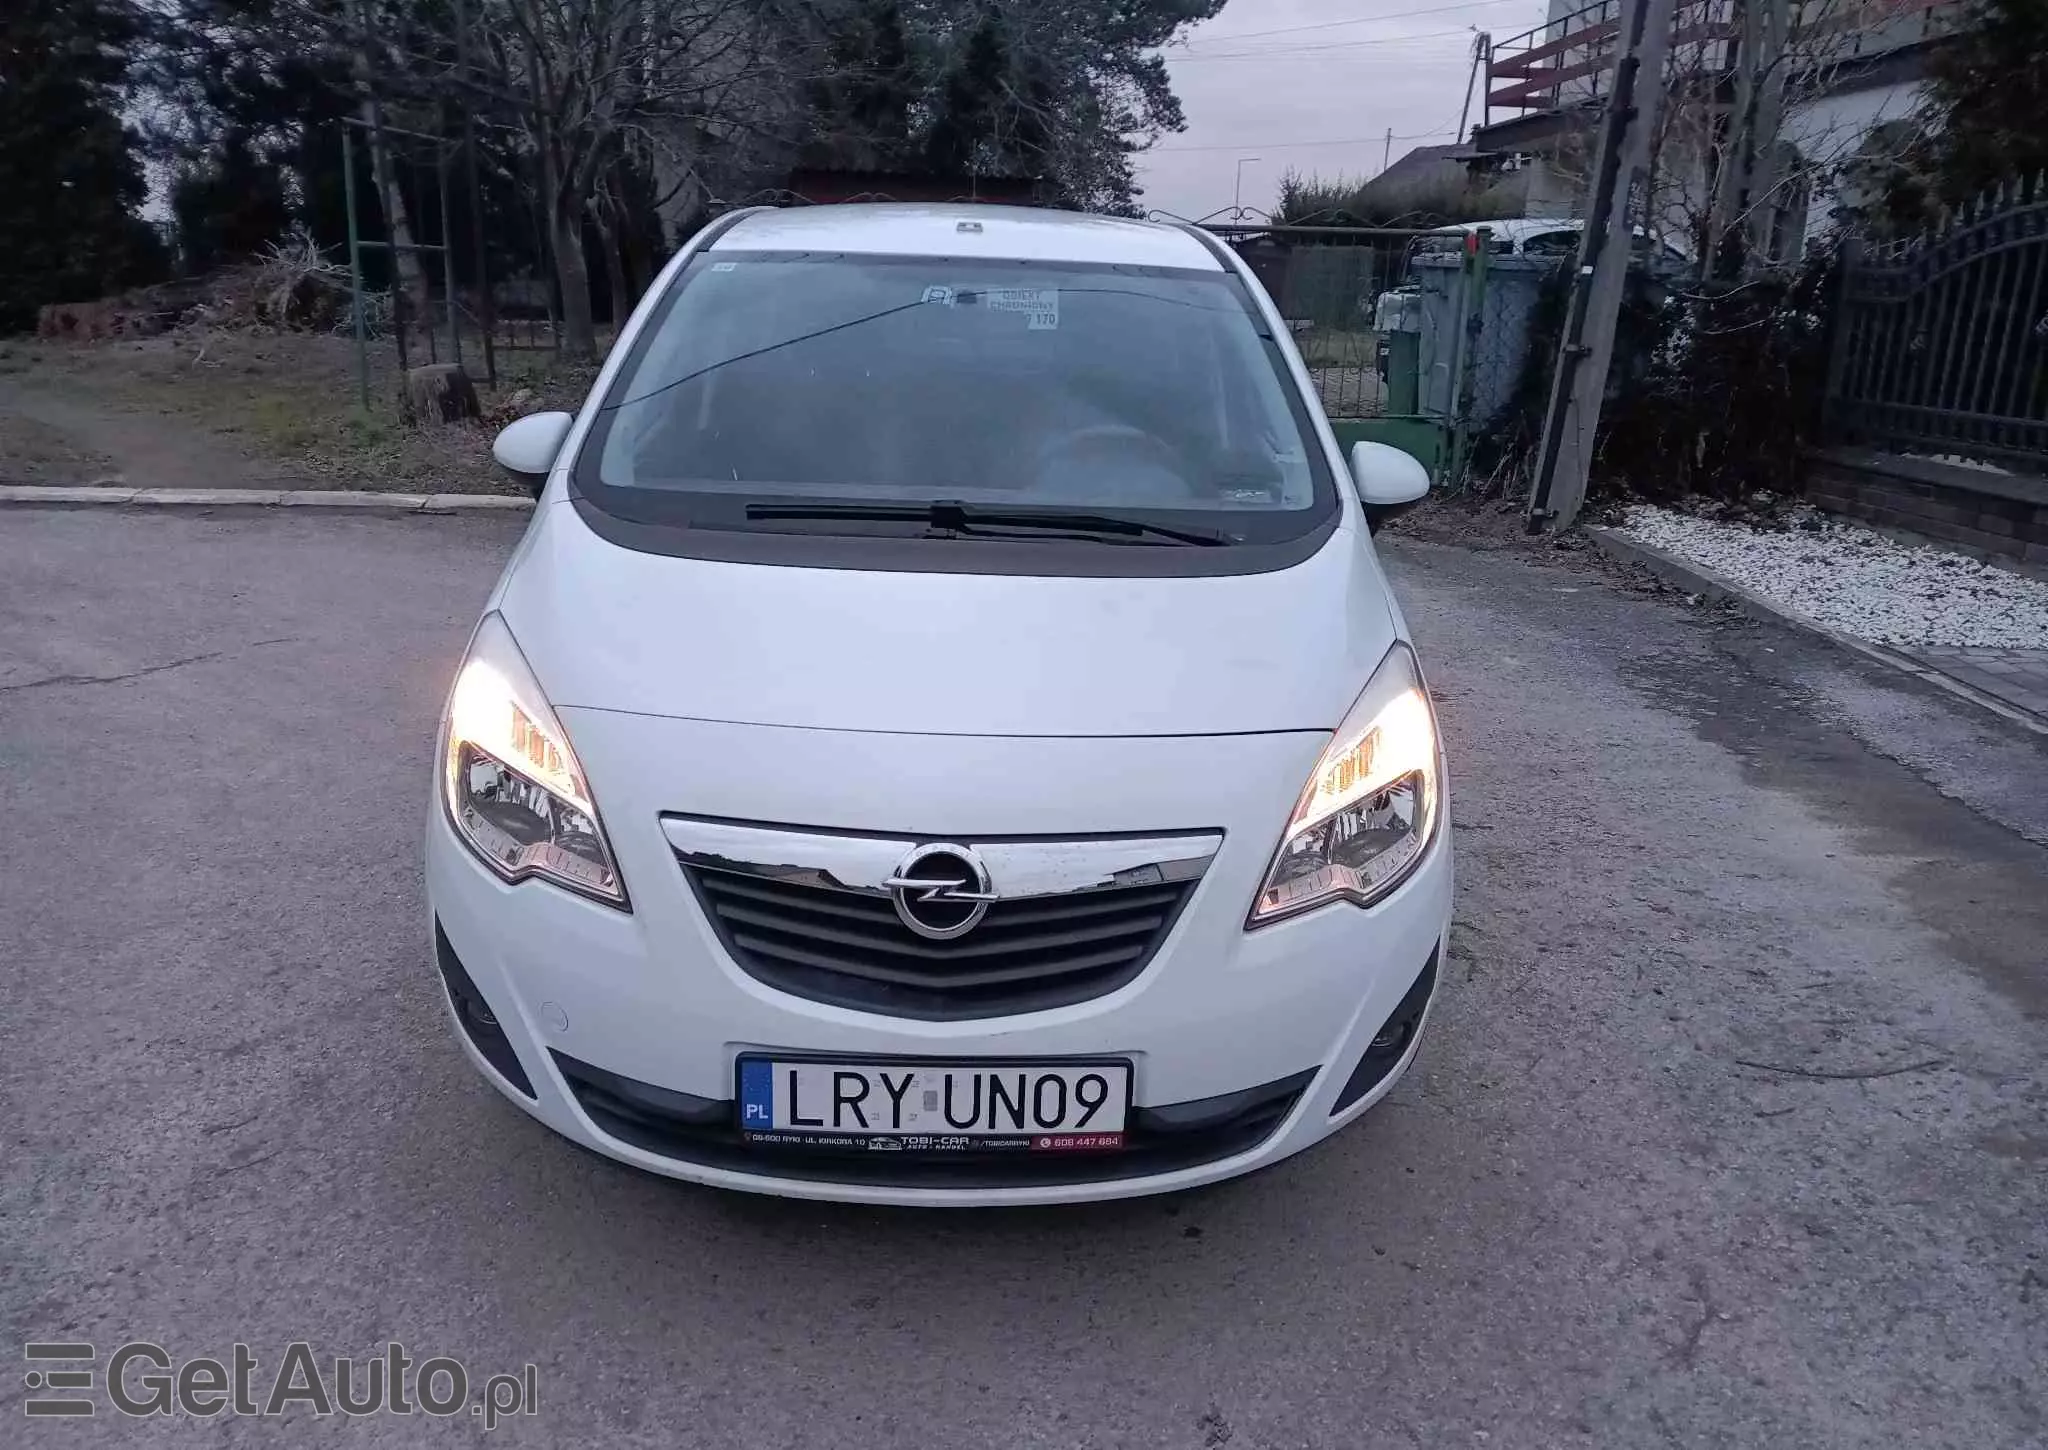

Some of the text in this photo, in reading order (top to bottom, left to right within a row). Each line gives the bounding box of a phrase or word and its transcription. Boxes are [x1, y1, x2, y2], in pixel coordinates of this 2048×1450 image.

[789, 1070, 1109, 1130] LRY UN09
[746, 1103, 769, 1120] PL
[901, 1136, 970, 1145] TOBI-CAR
[1076, 1137, 1097, 1146] 447
